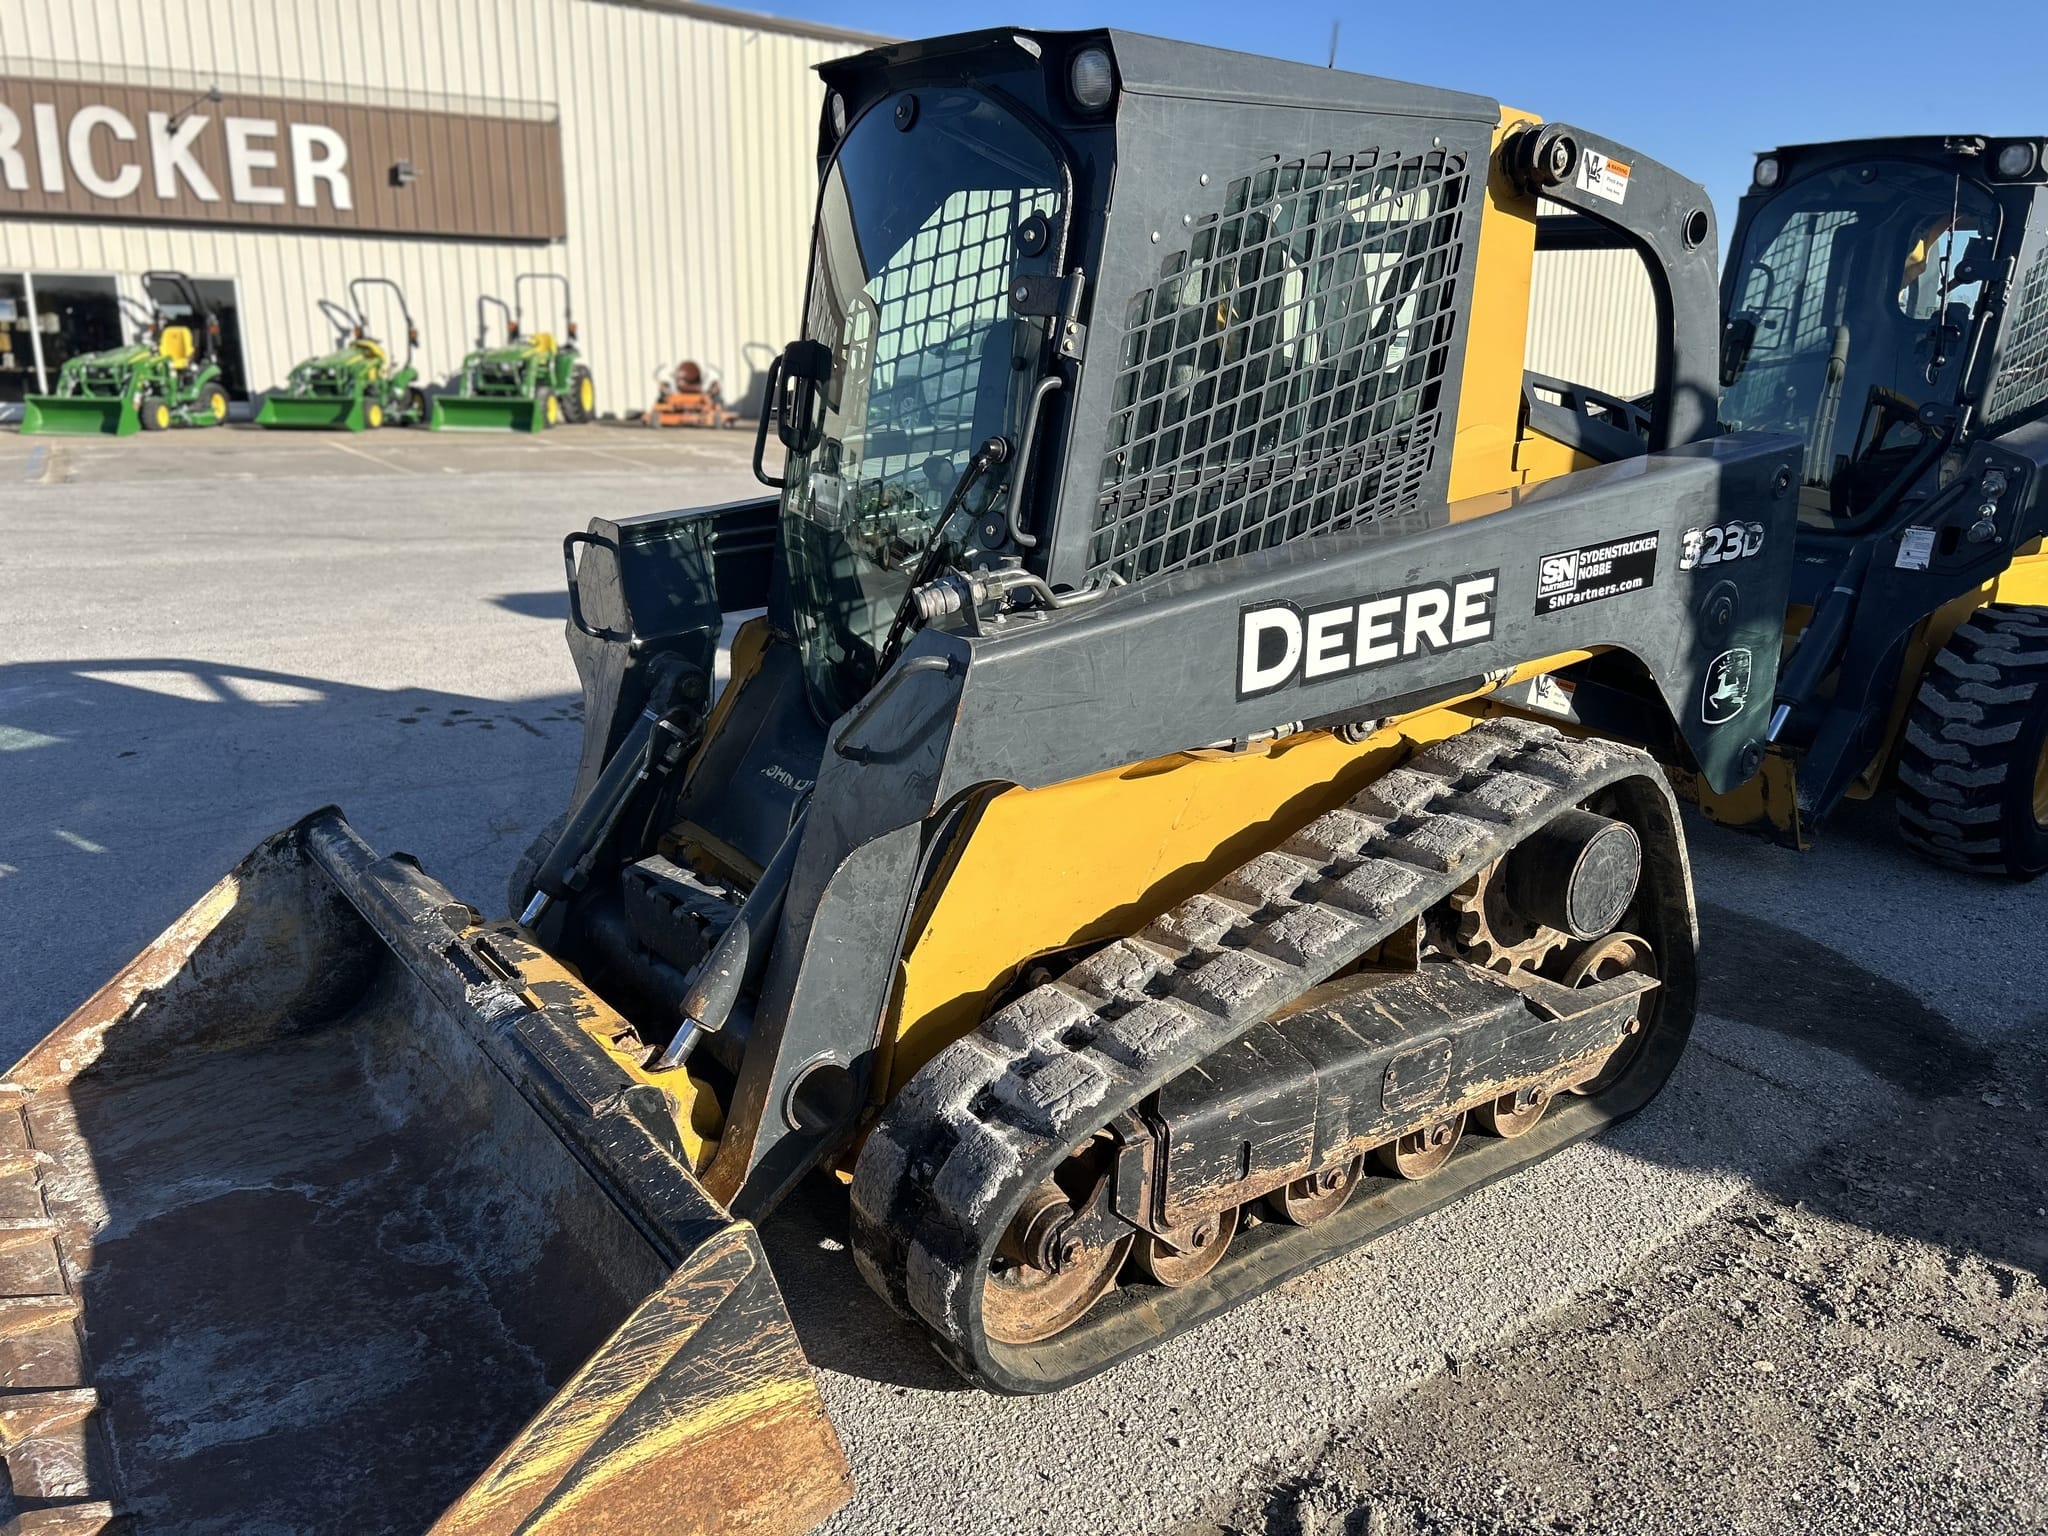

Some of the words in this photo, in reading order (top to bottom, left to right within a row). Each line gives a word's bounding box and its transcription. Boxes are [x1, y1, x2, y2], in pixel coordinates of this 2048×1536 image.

[1579, 537, 1658, 565] SYDENSTRICKER
[1680, 523, 1764, 570] 323D
[1542, 556, 1576, 584] SN
[1578, 561, 1612, 580] NOBBE
[1541, 580, 1573, 593] PARTNERS
[1549, 577, 1643, 608] SNPartners.com
[1241, 576, 1495, 693] DEERE
